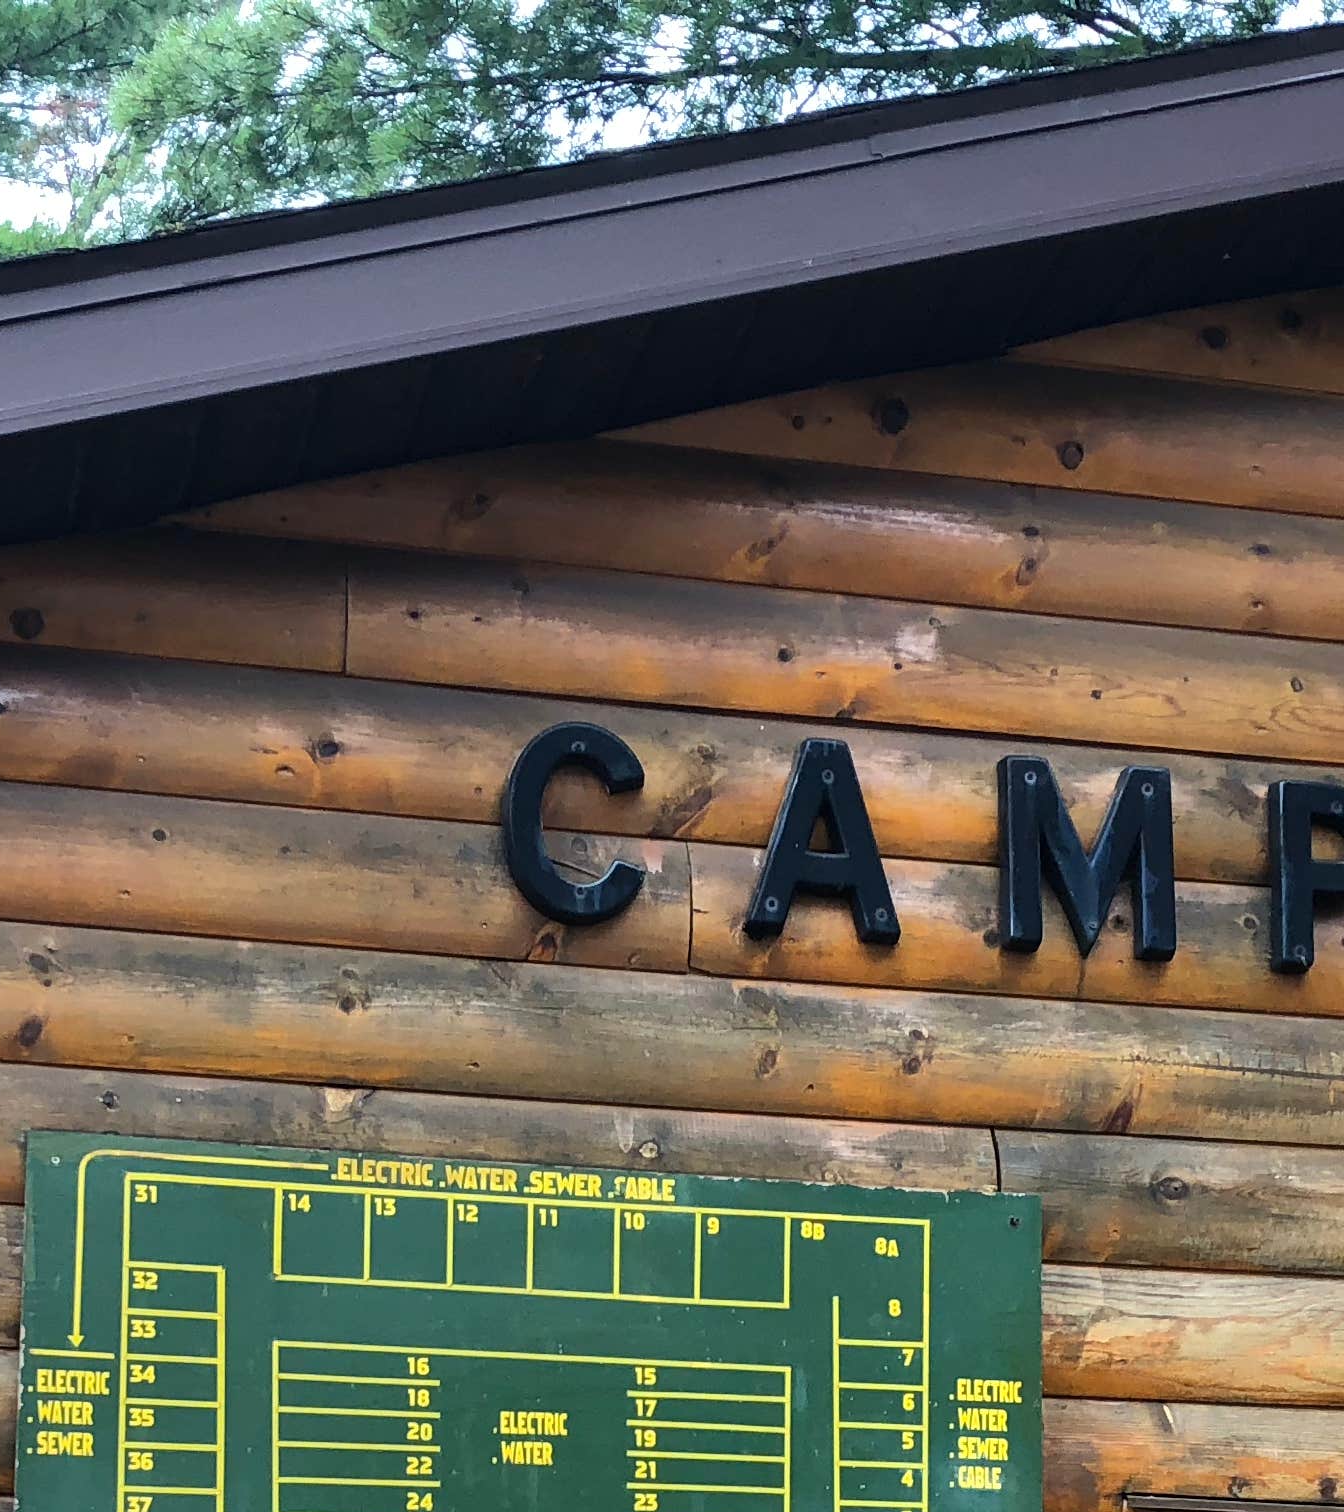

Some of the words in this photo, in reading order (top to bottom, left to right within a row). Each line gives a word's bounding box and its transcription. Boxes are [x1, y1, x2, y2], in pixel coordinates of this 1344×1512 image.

[136, 1185, 157, 1202] 31
[290, 1194, 311, 1211] 14
[376, 1198, 396, 1216] 13
[458, 1205, 478, 1222] 12
[540, 1209, 557, 1226] 11
[624, 1212, 645, 1230] 10
[708, 1217, 719, 1234] 9
[801, 1221, 825, 1240] 8B
[875, 1238, 898, 1256] 8A
[134, 1271, 158, 1290] 32
[889, 1300, 901, 1316] 8
[131, 1320, 156, 1338] 33
[409, 1357, 429, 1375] 16
[903, 1349, 914, 1365] 7
[130, 1365, 155, 1383] 34
[636, 1367, 656, 1385] 15
[409, 1389, 429, 1407] 18
[903, 1393, 914, 1411] 6
[129, 1408, 154, 1426] 35
[636, 1399, 657, 1417] 17
[407, 1422, 432, 1441] 20
[636, 1429, 656, 1447] 19
[903, 1432, 914, 1449] 5
[129, 1452, 153, 1470] 36
[407, 1457, 432, 1474] 22
[635, 1461, 656, 1479] 21
[901, 1470, 913, 1488] 4
[407, 1493, 433, 1511] 24
[634, 1493, 658, 1511] 23
